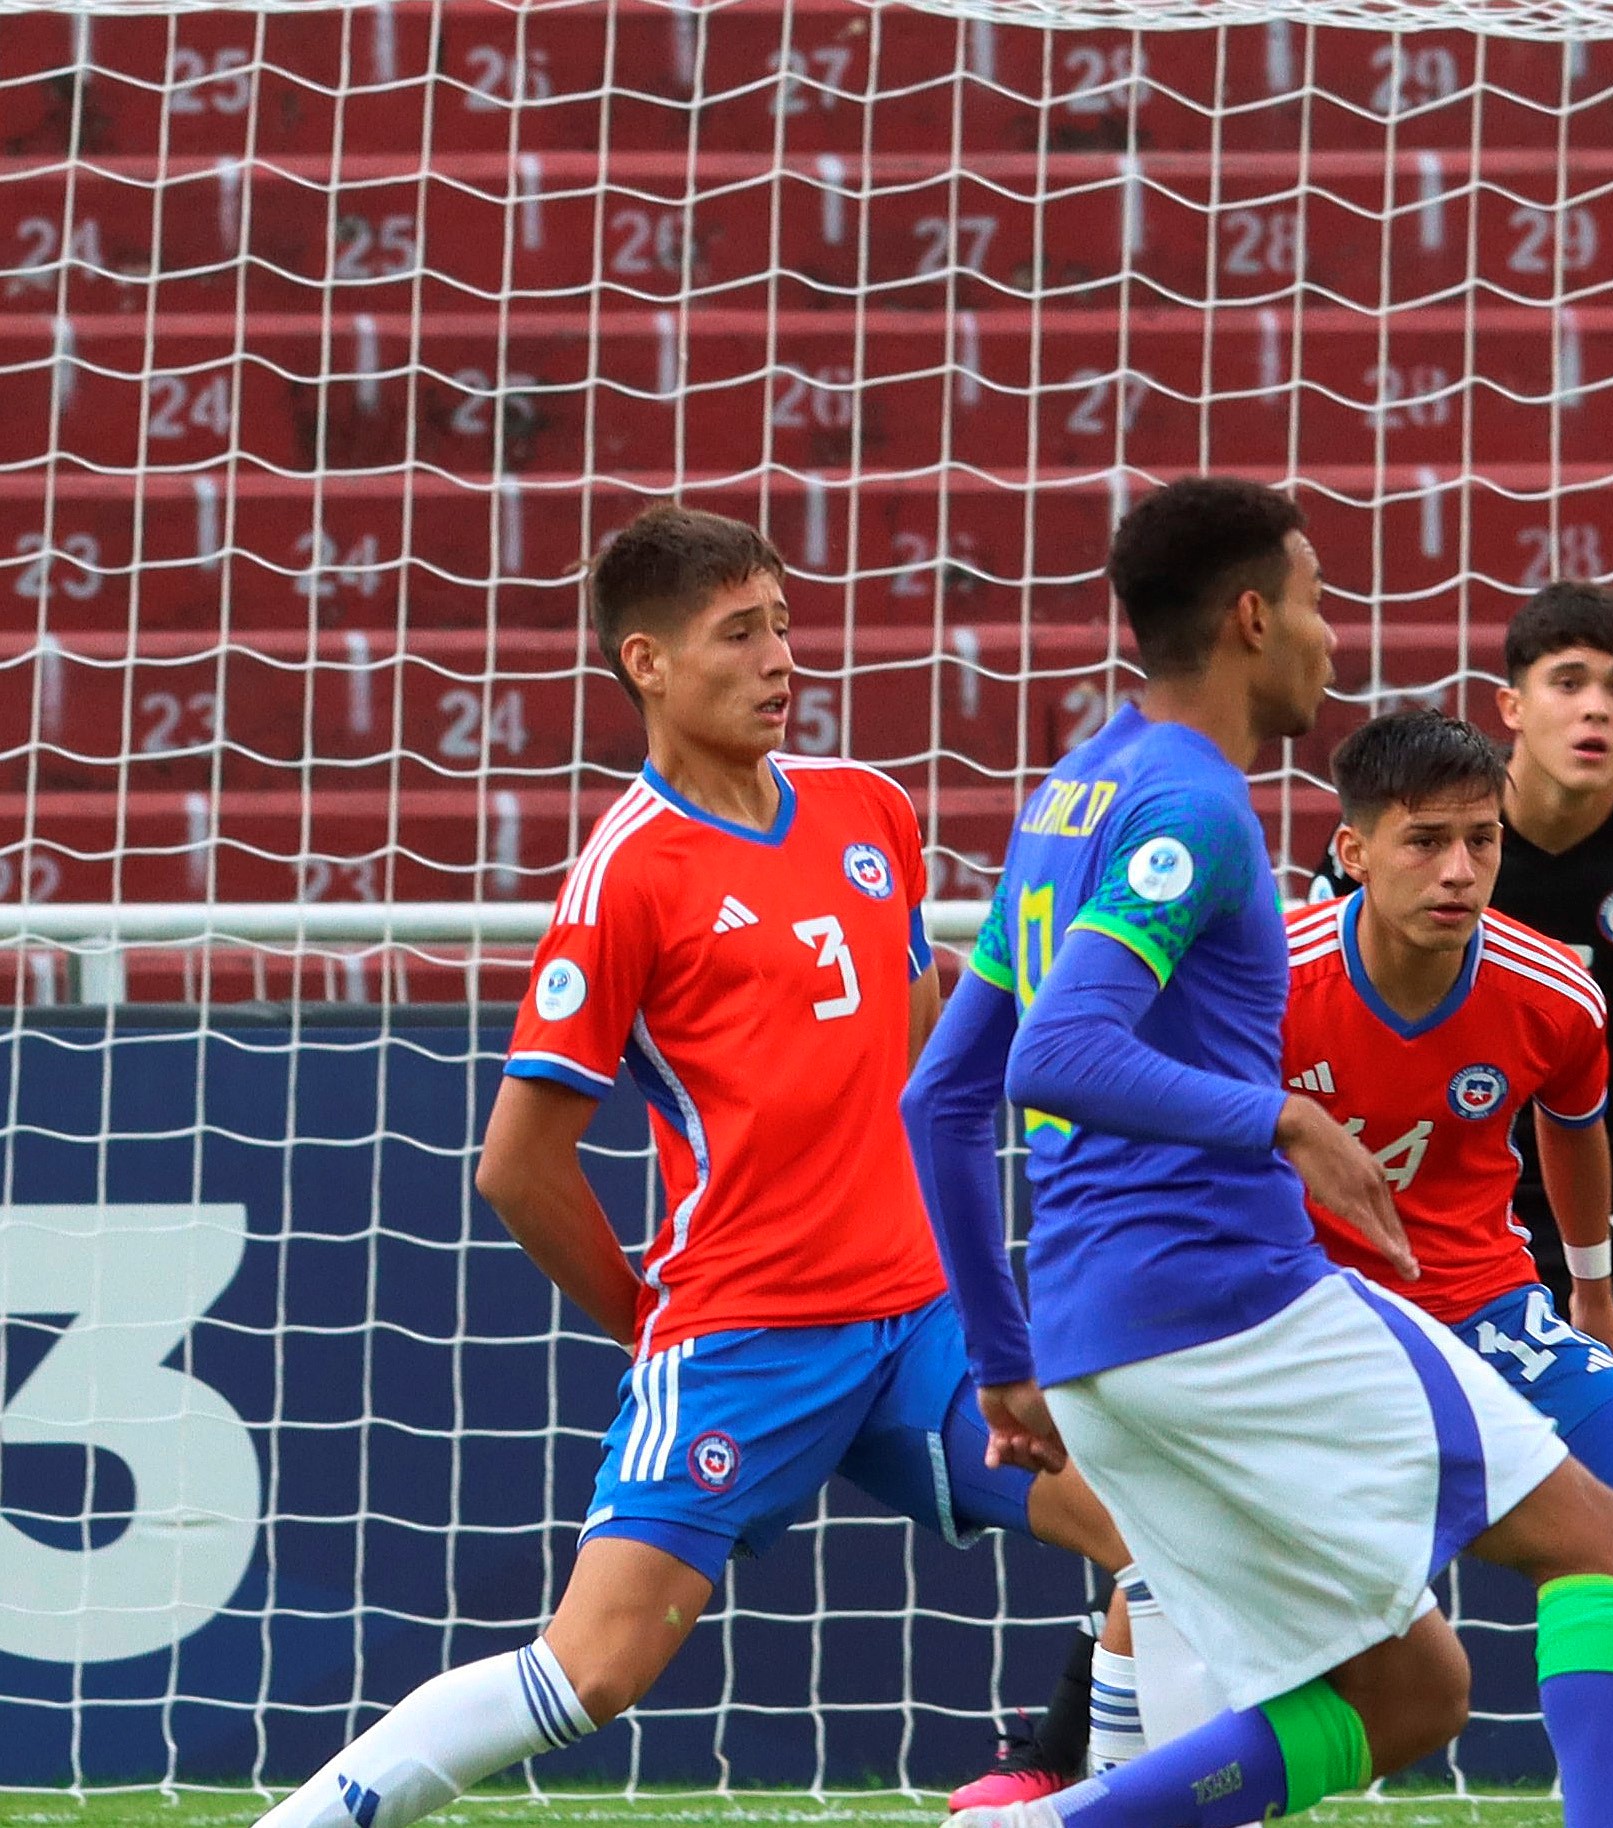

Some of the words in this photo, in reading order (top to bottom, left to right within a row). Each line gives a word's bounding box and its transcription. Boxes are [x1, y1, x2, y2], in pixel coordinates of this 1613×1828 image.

[168, 49, 251, 113] 25
[465, 47, 550, 111] 26
[767, 48, 852, 116] 27
[1064, 47, 1147, 114] 28
[1370, 48, 1457, 112] 29
[16, 219, 100, 282] 24
[333, 216, 416, 279] 25
[610, 211, 696, 274] 26
[914, 217, 997, 274] 27
[1225, 213, 1308, 274] 28
[1508, 208, 1597, 271] 29
[146, 376, 232, 438] 24
[773, 365, 852, 428] 26
[1066, 370, 1142, 434] 27
[1362, 369, 1450, 431] 28
[14, 534, 100, 598] 23
[293, 530, 380, 598] 24
[1517, 525, 1602, 588] 28
[140, 693, 225, 754] 23
[439, 691, 527, 756] 24
[793, 687, 838, 755] 5
[791, 915, 862, 1021] 3
[1475, 1290, 1592, 1382] 14
[0, 1203, 261, 1663] 3
